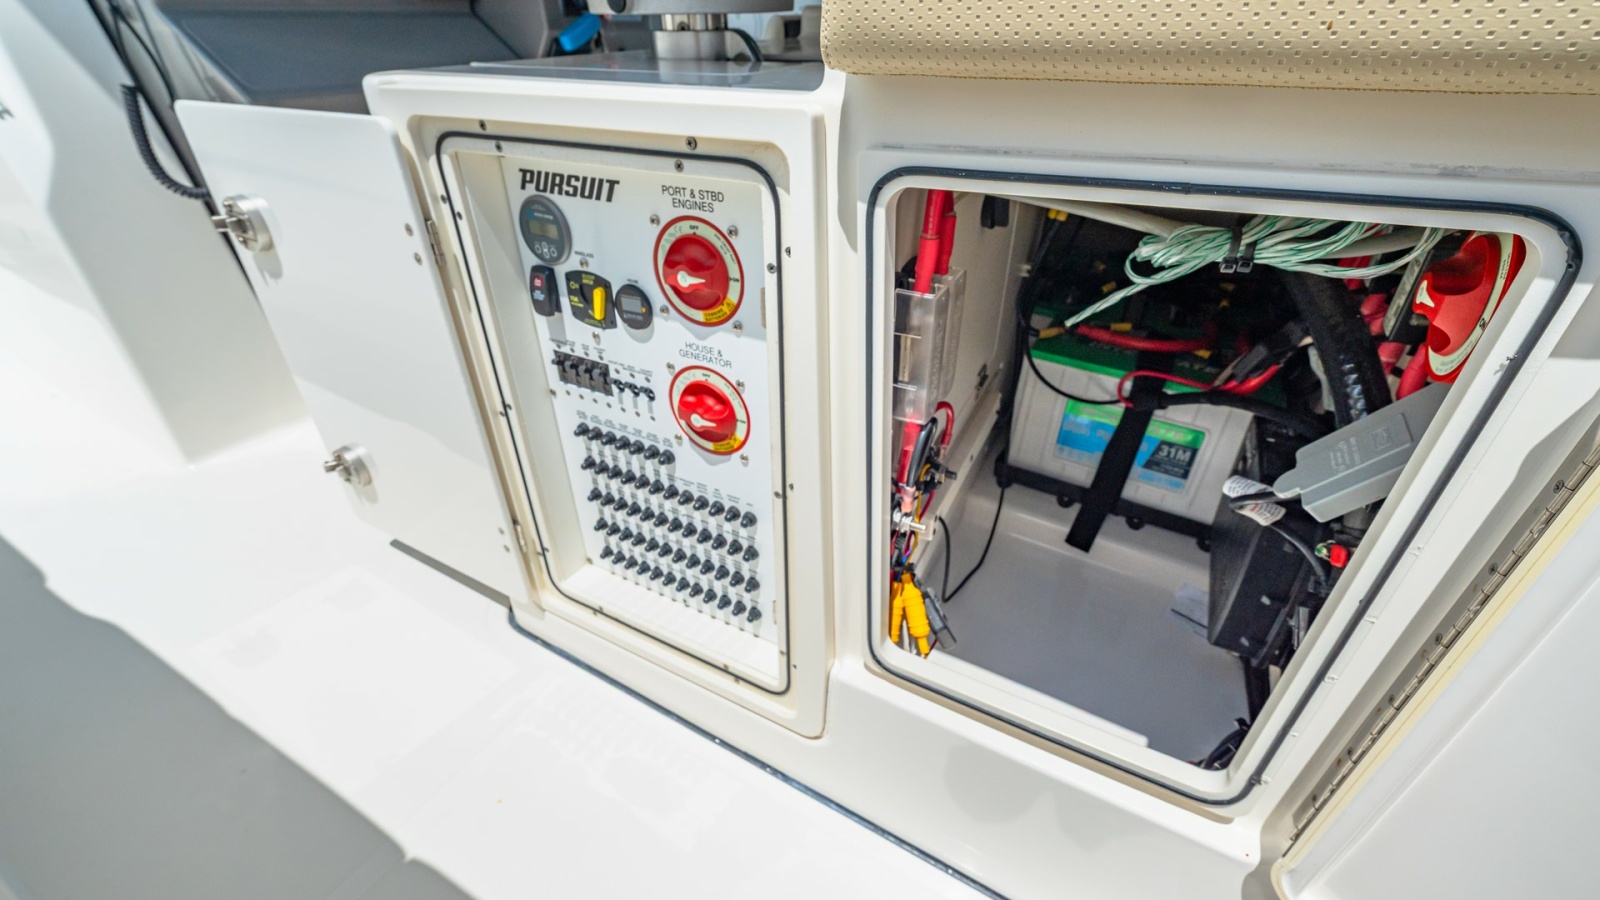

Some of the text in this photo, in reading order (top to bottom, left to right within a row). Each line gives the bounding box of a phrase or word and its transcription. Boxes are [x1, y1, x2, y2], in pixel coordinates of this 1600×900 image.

[519, 168, 620, 203] PURSUIT
[661, 185, 725, 203] PORT & STBD
[672, 198, 714, 213] ENGINES
[685, 342, 723, 357] HOUSE &
[678, 349, 732, 369] GENERATOR
[1159, 445, 1192, 461] 31M
